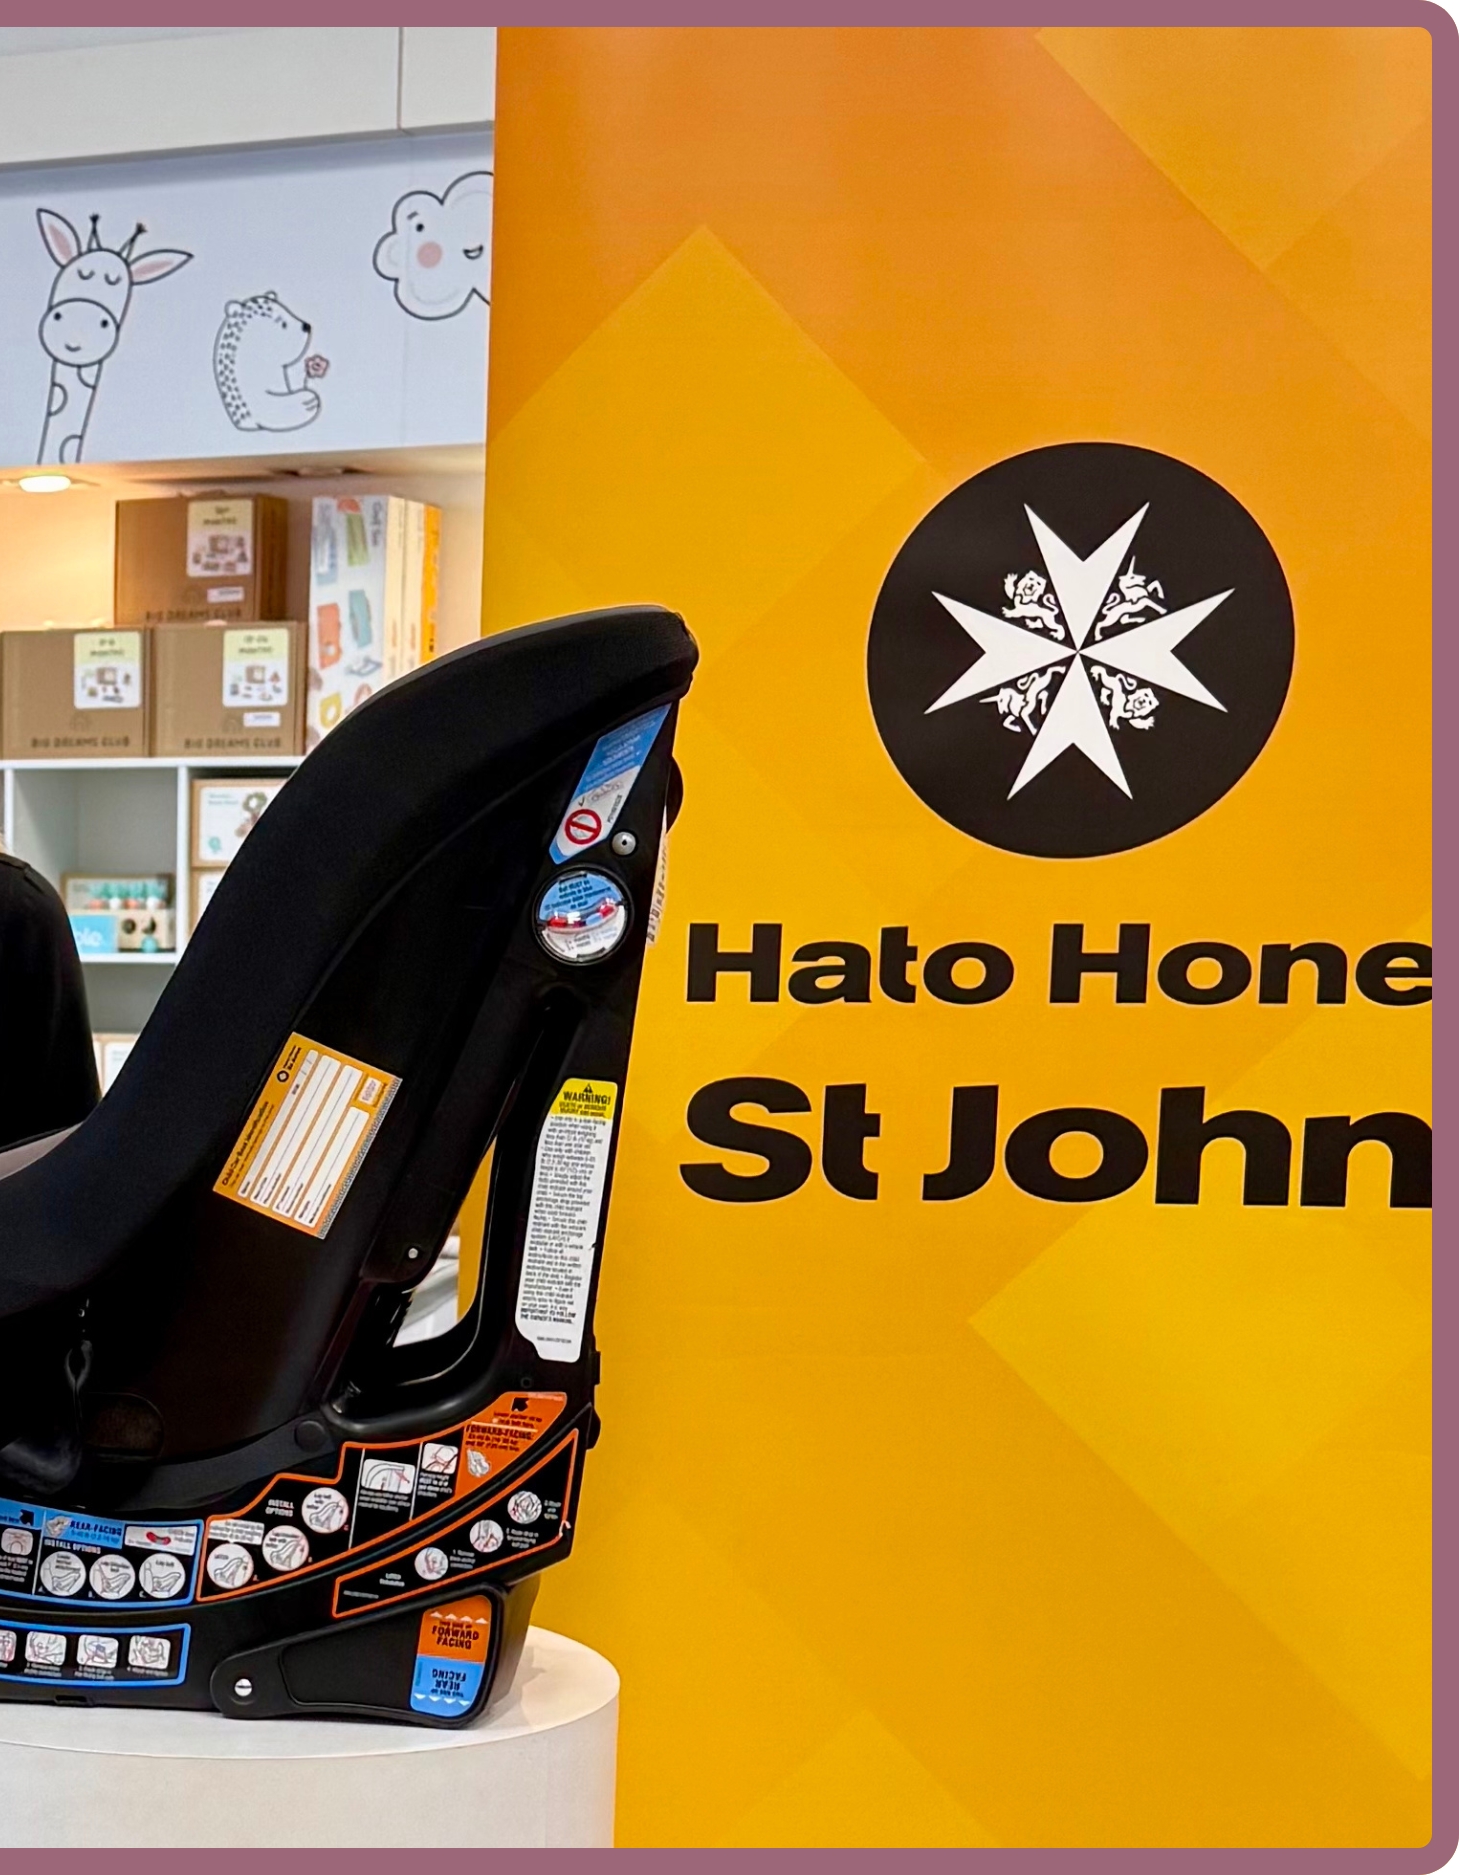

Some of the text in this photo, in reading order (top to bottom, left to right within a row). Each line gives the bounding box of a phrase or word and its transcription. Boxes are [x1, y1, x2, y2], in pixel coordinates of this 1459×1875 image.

[686, 922, 1432, 1006] Hato Hone
[563, 1090, 611, 1105] WARNING!
[678, 1075, 1432, 1209] St John
[69, 1519, 122, 1537] REAR-FACING
[432, 1626, 479, 1640] FORWARD
[436, 1637, 472, 1650] FACING
[432, 1668, 466, 1682] FACING
[435, 1680, 460, 1690] REAR
